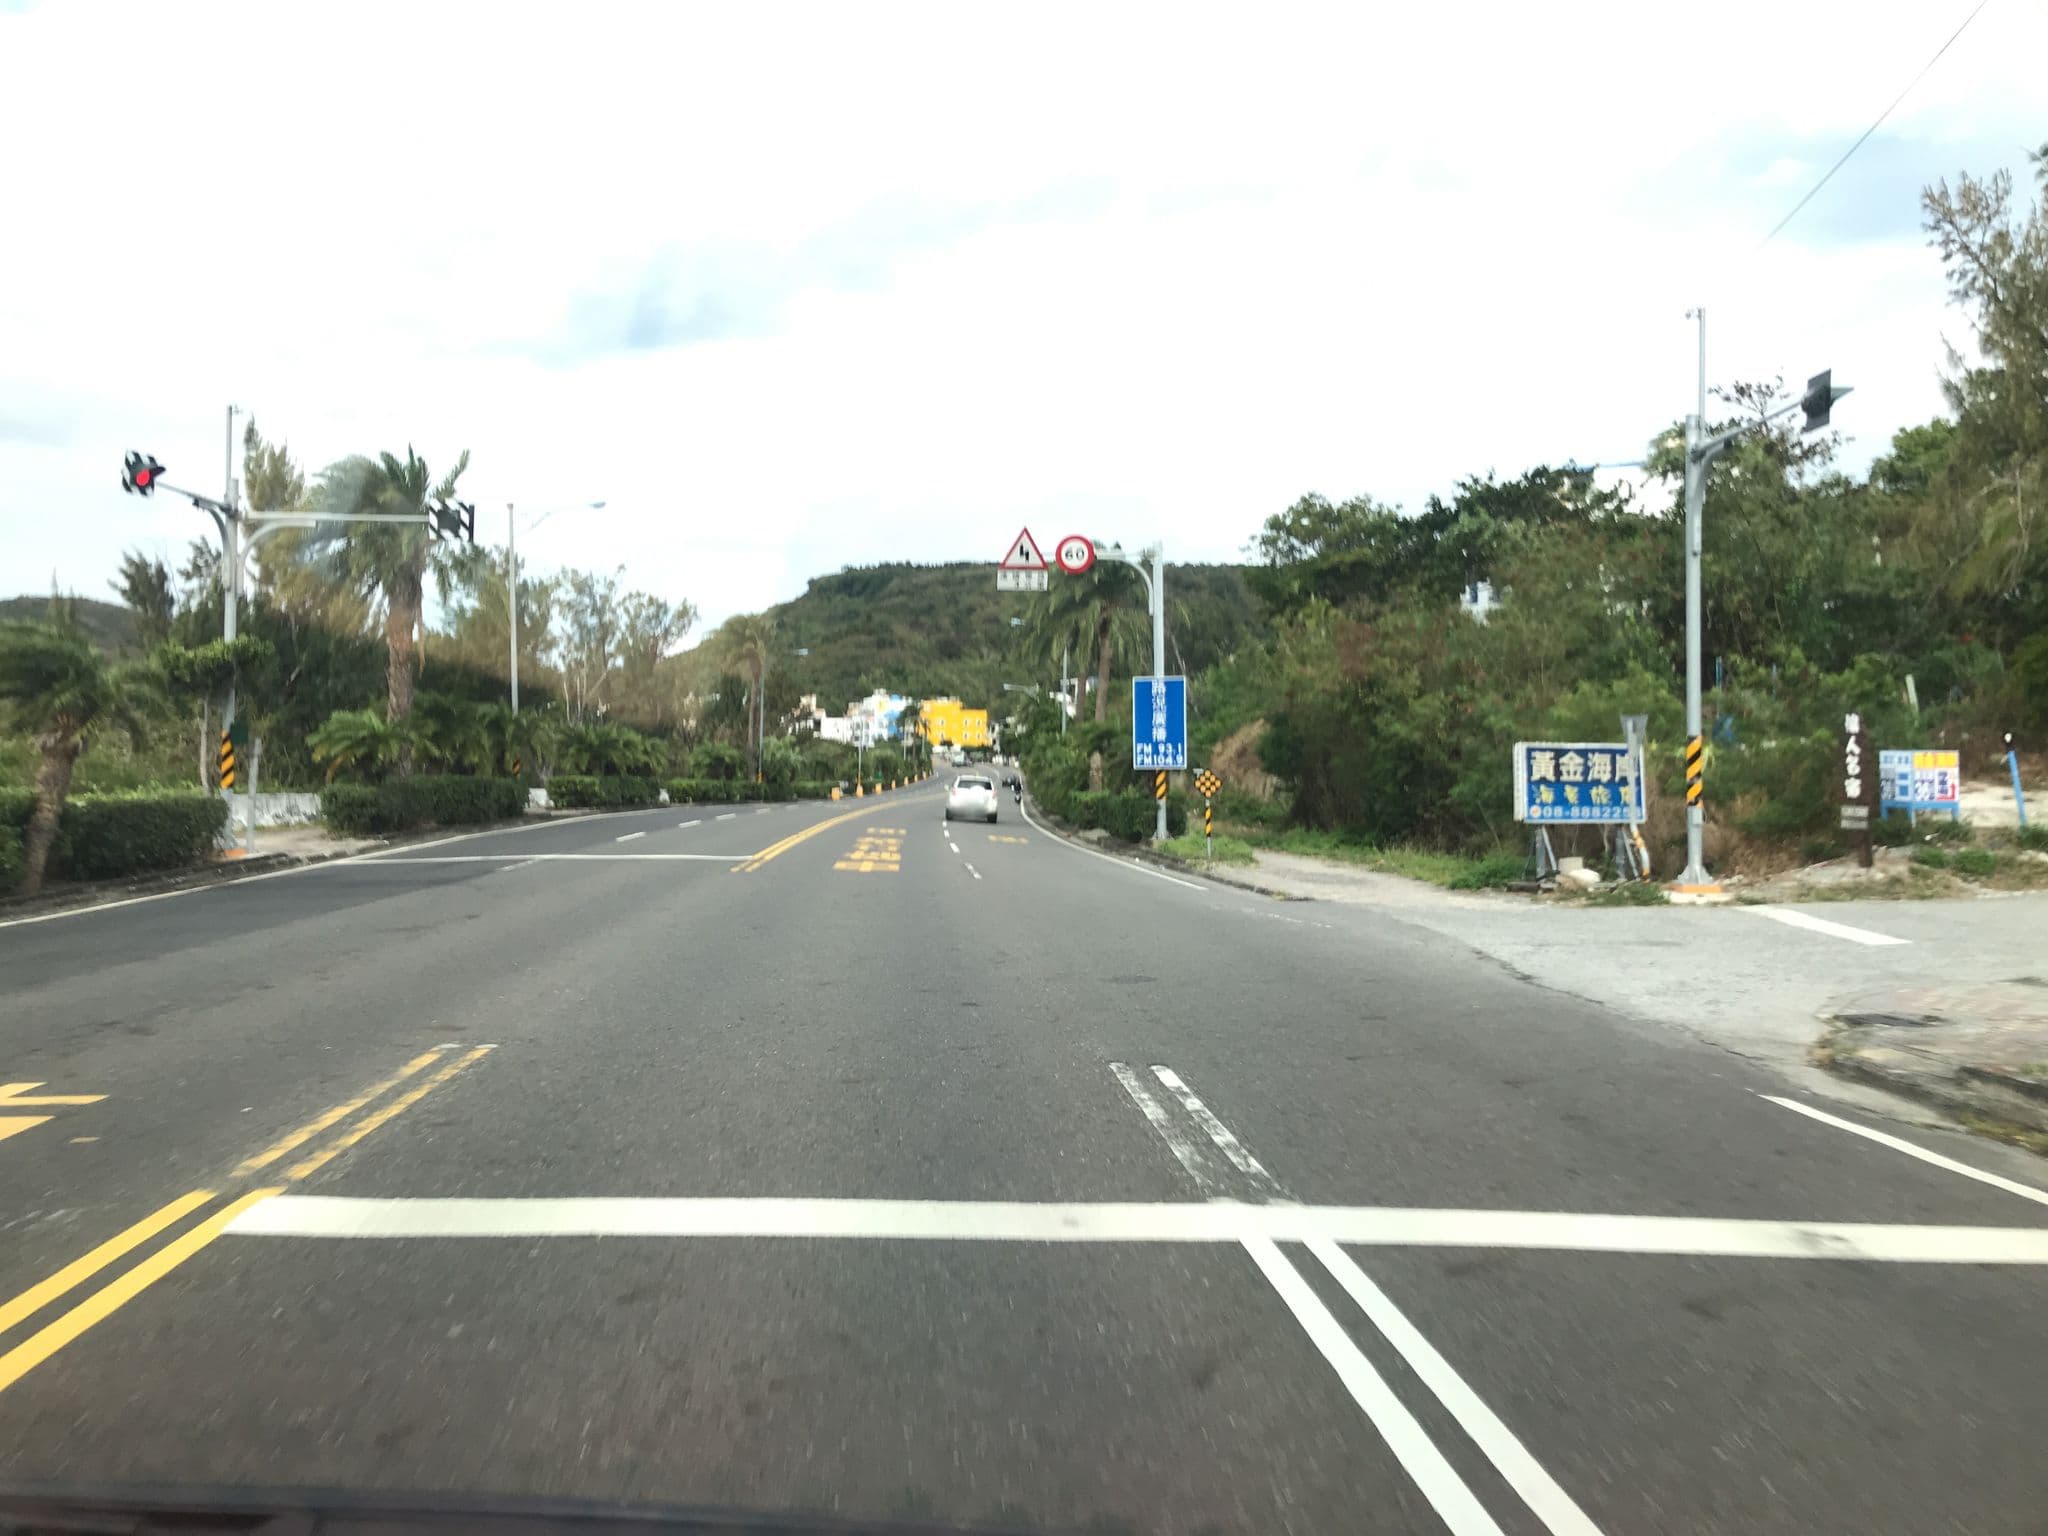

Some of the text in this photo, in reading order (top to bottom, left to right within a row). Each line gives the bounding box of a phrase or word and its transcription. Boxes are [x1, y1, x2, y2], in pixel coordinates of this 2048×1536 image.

[1064, 546, 1085, 561] 60
[1137, 743, 1182, 754] FM 93.1
[1530, 751, 1639, 782] 黃金海岸
